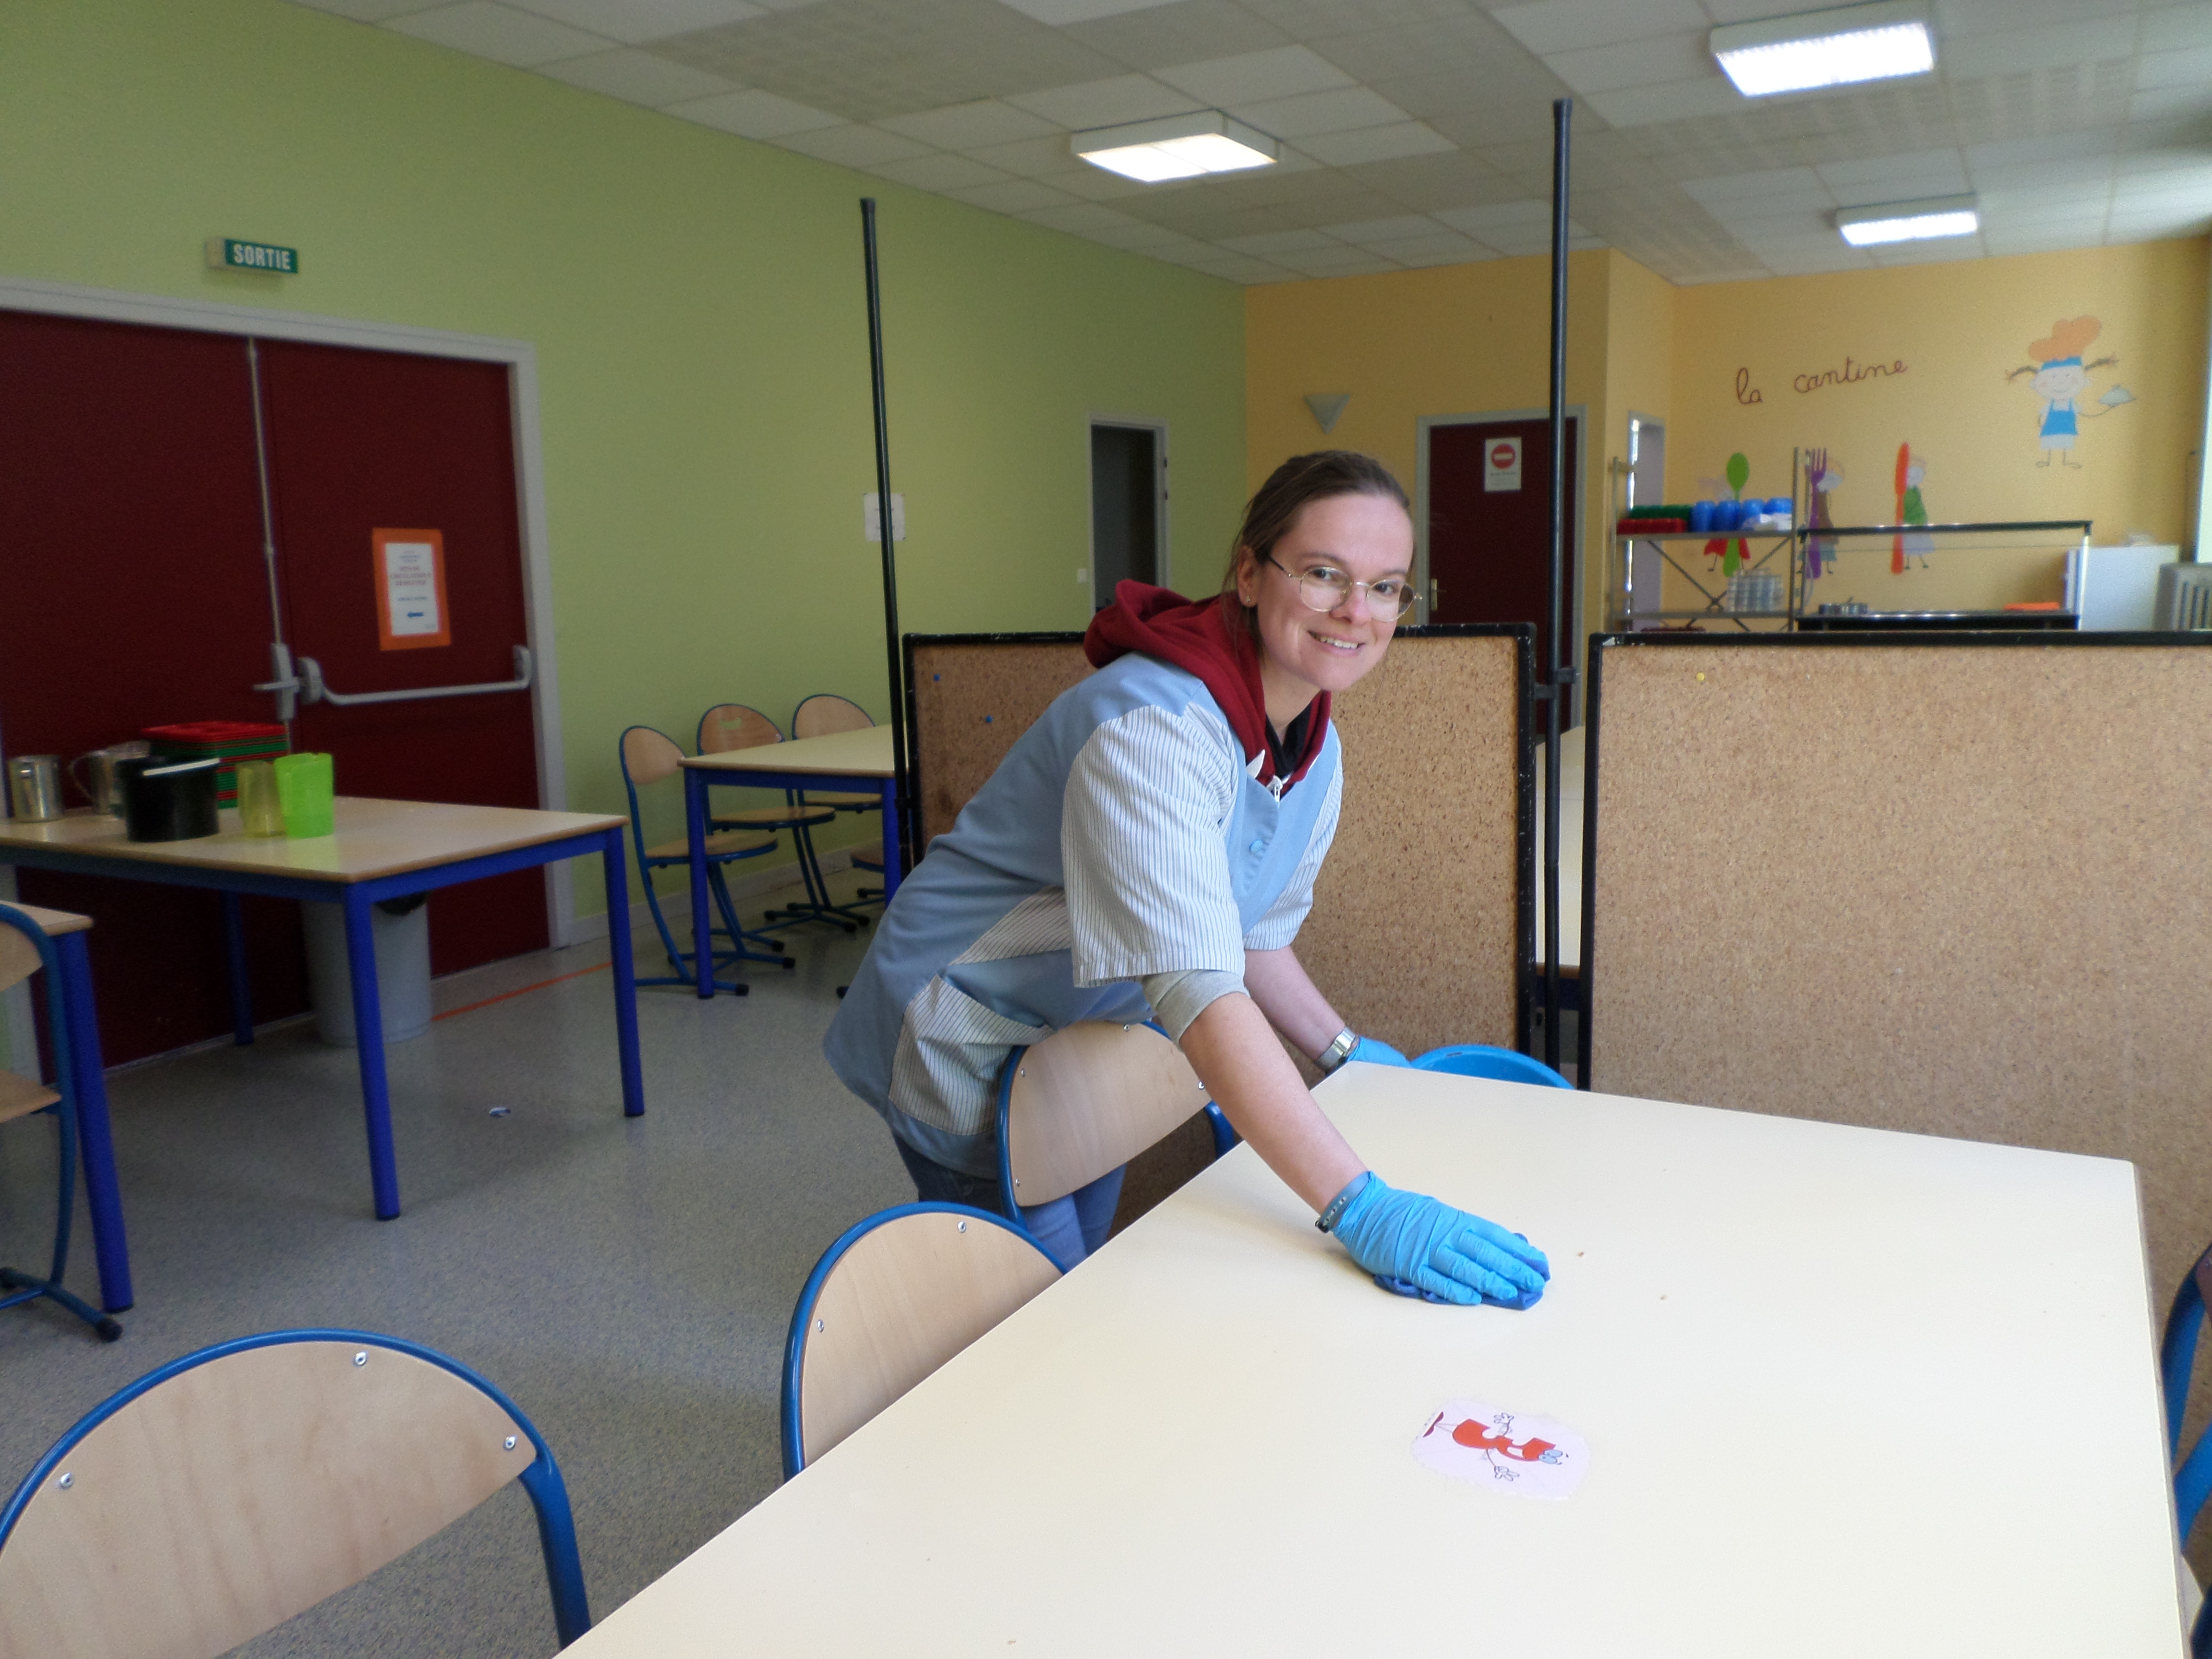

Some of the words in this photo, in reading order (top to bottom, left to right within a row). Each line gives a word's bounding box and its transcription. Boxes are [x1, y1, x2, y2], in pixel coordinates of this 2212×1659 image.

[233, 243, 291, 270] SORTIE
[1736, 368, 1762, 405] la
[1794, 357, 1908, 393] cantine
